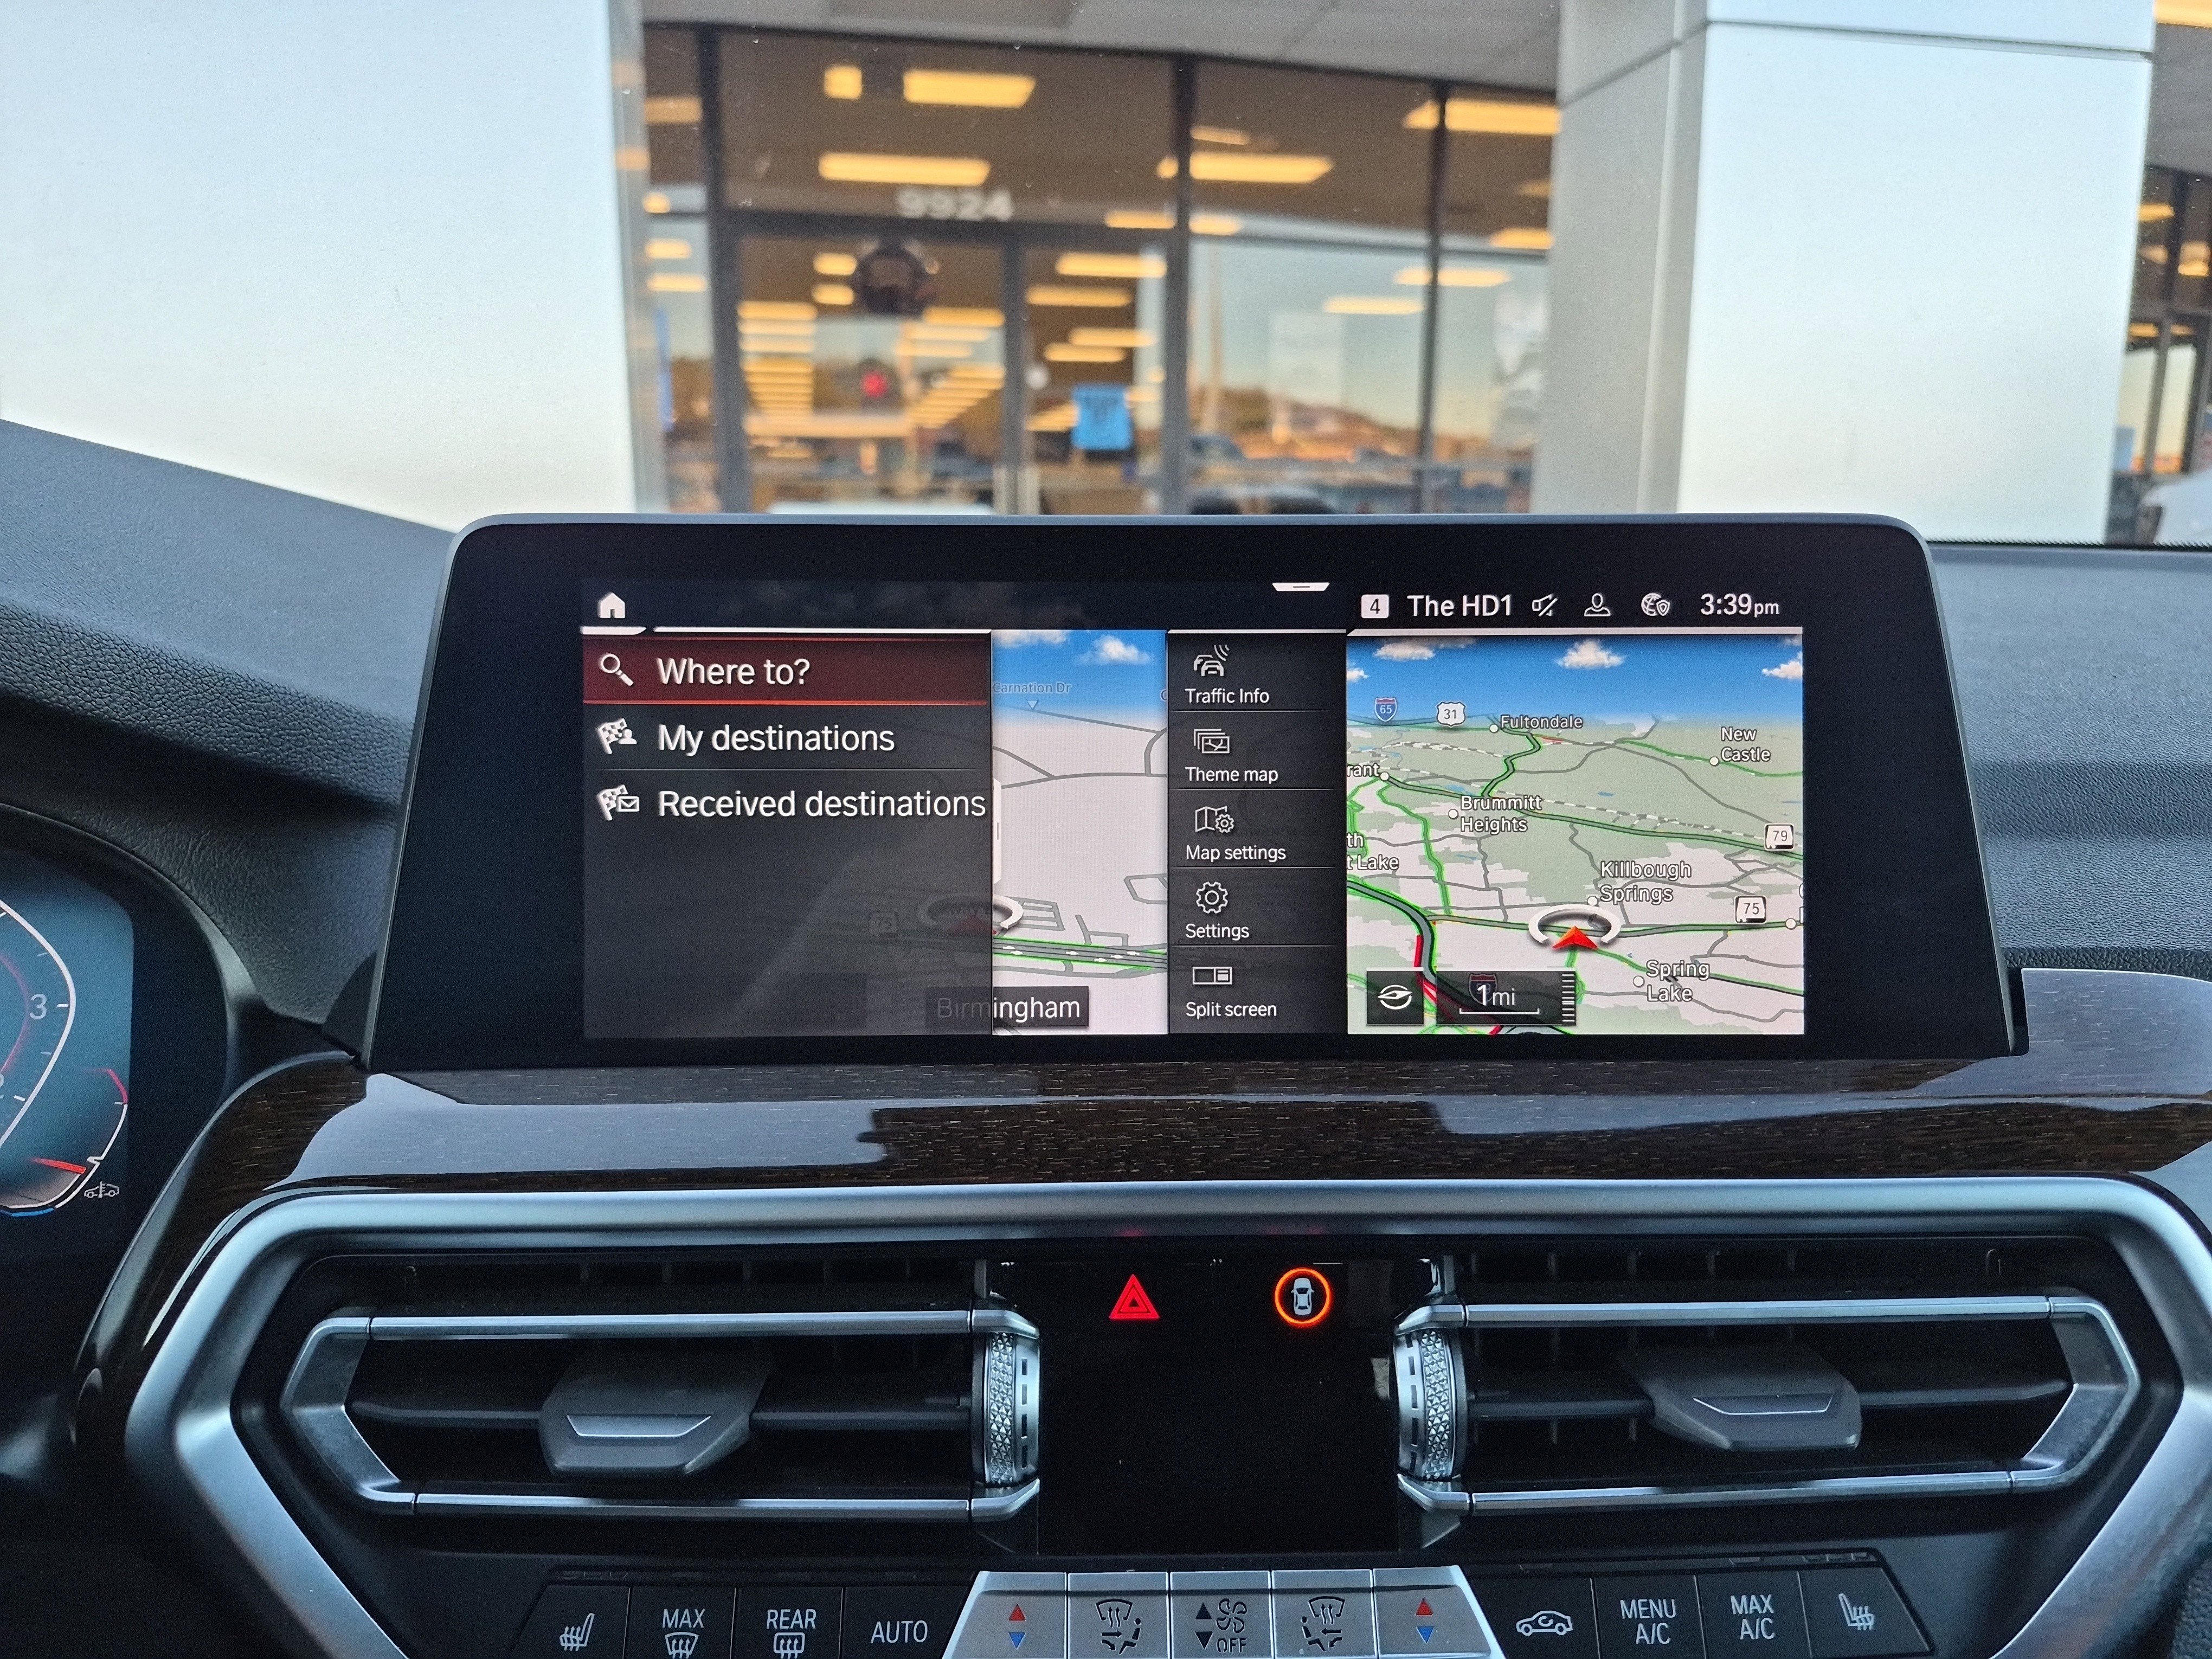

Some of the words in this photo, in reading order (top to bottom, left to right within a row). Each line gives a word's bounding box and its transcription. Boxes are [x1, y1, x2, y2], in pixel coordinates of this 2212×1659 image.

[896, 187, 1013, 221] 9924
[1370, 599, 1380, 615] 4
[1407, 594, 1454, 616] The
[1462, 594, 1512, 616] HD1
[657, 658, 755, 685] Where
[764, 658, 810, 685] to?
[993, 681, 1053, 694] Carnation
[1054, 681, 1072, 693] Dr
[1185, 688, 1235, 703] Traffic
[1239, 687, 1270, 703] Info
[1380, 705, 1392, 714] 65
[1443, 709, 1457, 719] 31
[1500, 715, 1583, 729] Fultondale
[658, 724, 704, 756] My
[712, 724, 895, 751] destinations
[1720, 726, 1757, 741] New
[1720, 747, 1771, 762] Castle
[1185, 767, 1239, 782] Theme
[1244, 769, 1278, 785] map
[658, 789, 796, 818] Received
[806, 790, 986, 818] destinations
[1460, 795, 1542, 811] Brummitt
[1460, 817, 1528, 834] Heights
[1773, 829, 1788, 841] 79
[1186, 845, 1220, 863] Map
[1224, 845, 1287, 863] settings
[1357, 854, 1399, 870] Lake
[1600, 860, 1692, 880] Killbough
[1600, 884, 1674, 905] Springs
[1743, 902, 1760, 915] 75
[1186, 923, 1250, 941] Settings
[1646, 960, 1711, 980] Spring
[1647, 985, 1693, 1002] Lake
[29, 993, 47, 1020] 3
[937, 996, 1080, 1023] Birmingham
[1186, 1001, 1221, 1019] Split
[1225, 1004, 1277, 1017] screen
[1619, 1598, 1676, 1619] MENU
[1730, 1594, 1773, 1616] MAX
[662, 1608, 706, 1629] MAX
[766, 1609, 816, 1630] REAR
[870, 1620, 928, 1644] AUTO
[1635, 1623, 1671, 1645] A/C
[1740, 1618, 1776, 1640] A/C
[1217, 1637, 1247, 1654] OFF
